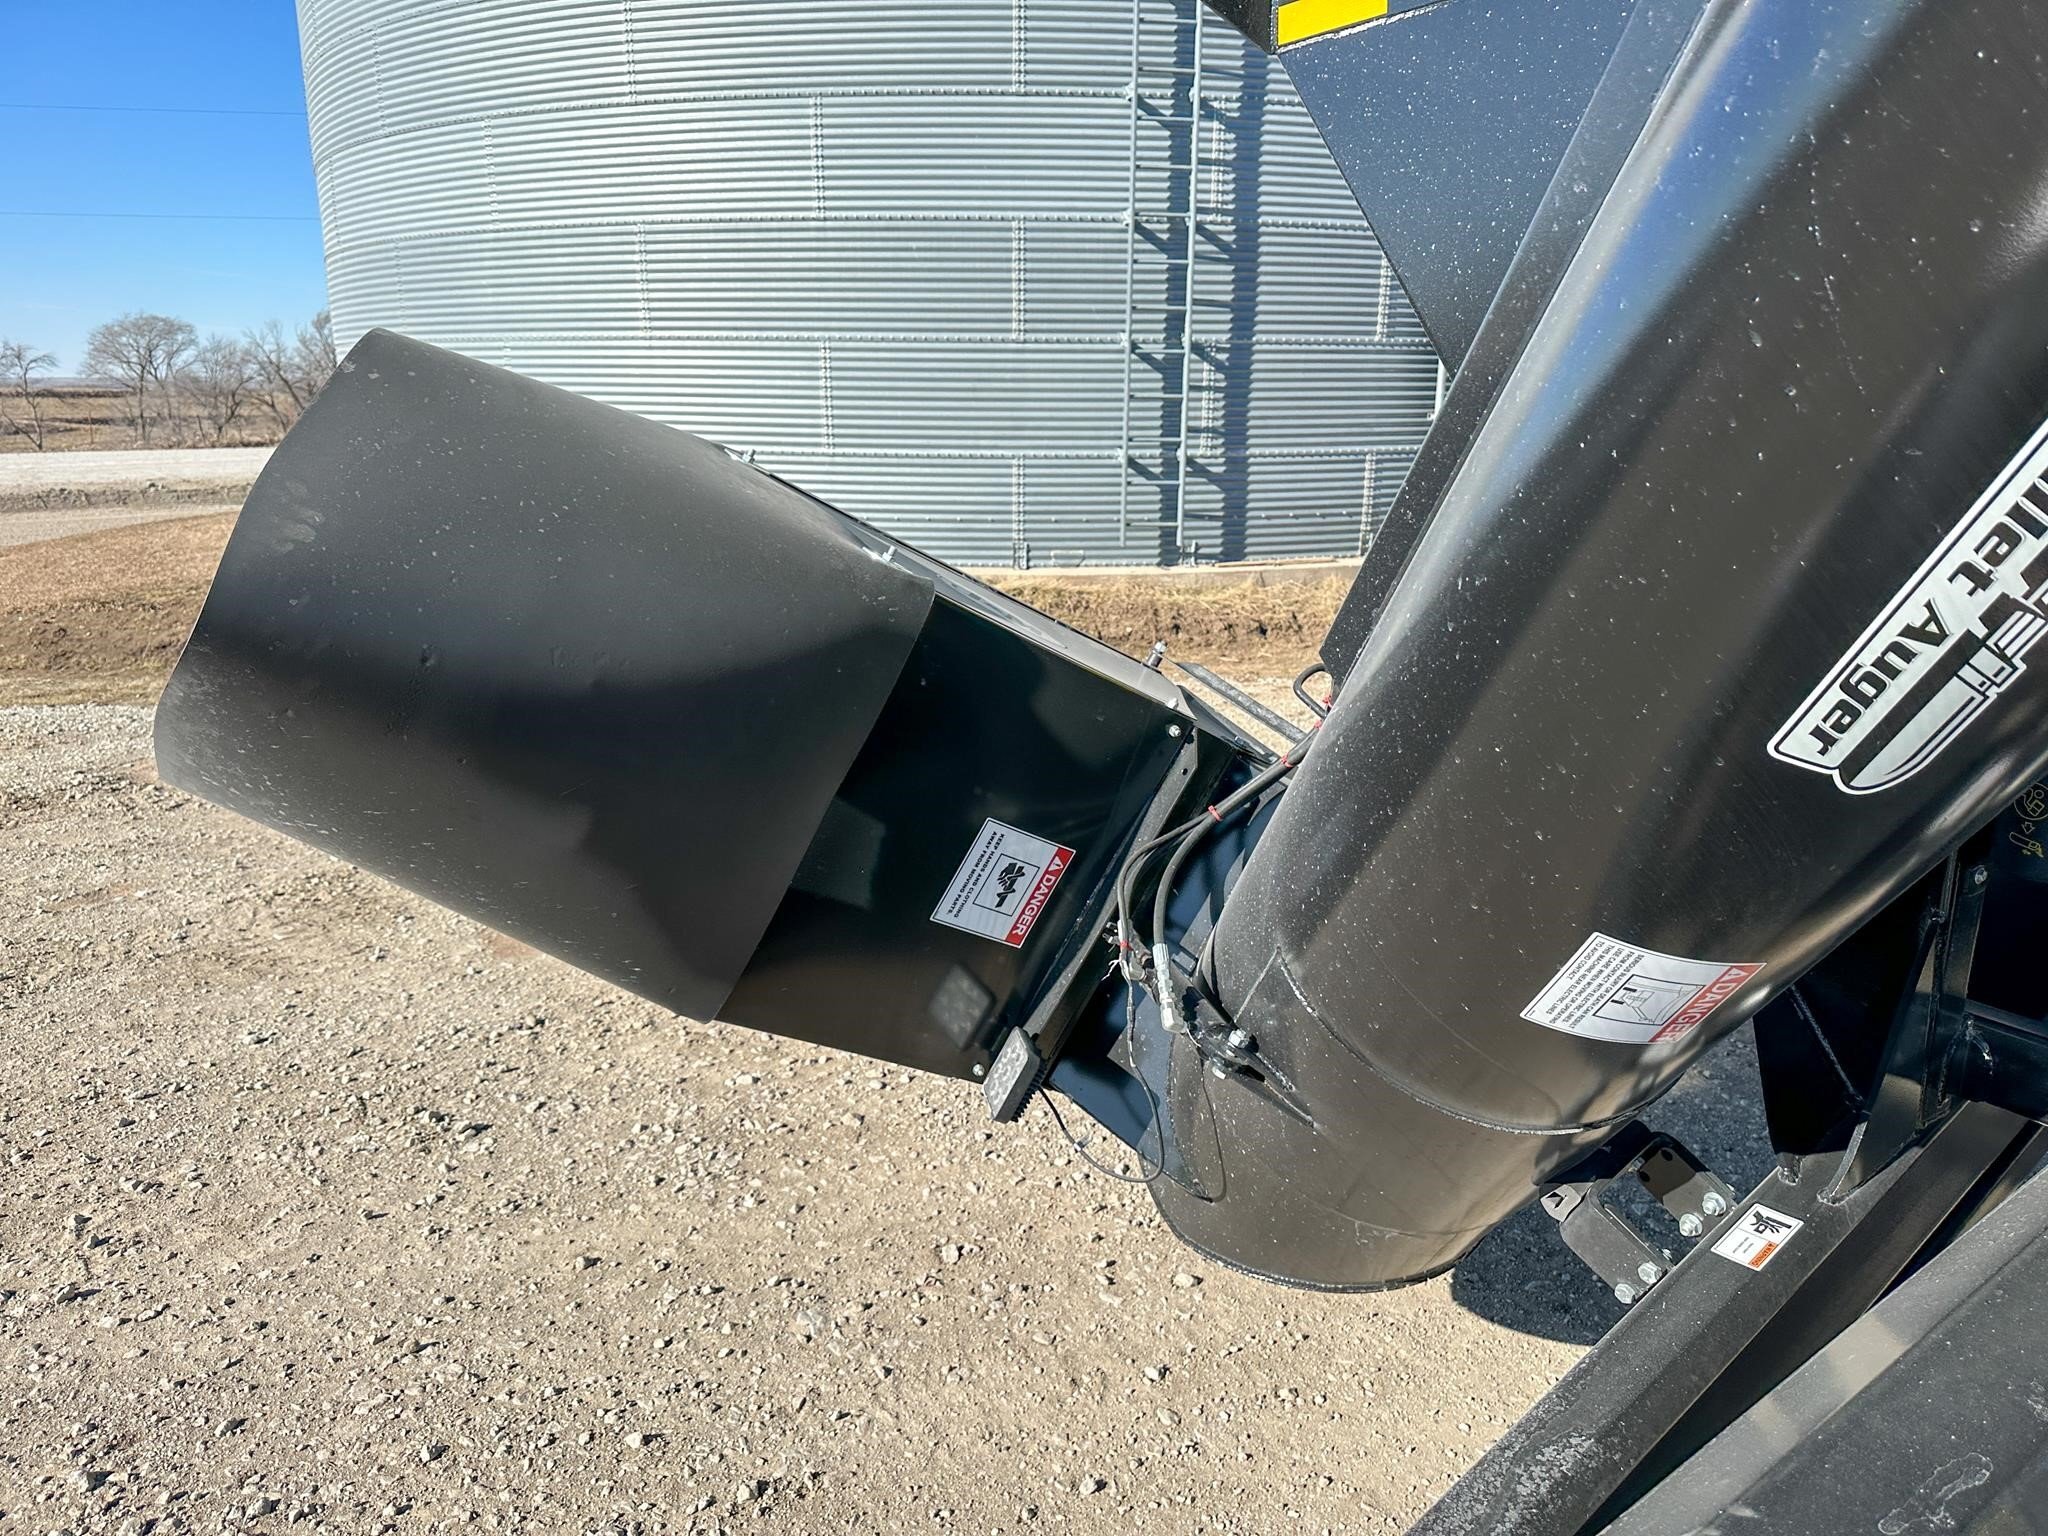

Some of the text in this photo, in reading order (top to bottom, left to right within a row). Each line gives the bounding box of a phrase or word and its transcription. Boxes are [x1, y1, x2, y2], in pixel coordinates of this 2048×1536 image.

[1808, 466, 2048, 757] llet Auger
[974, 850, 988, 868] FROM
[984, 831, 998, 849] AWAY
[953, 833, 1005, 918] KEEP HANDS AND CLOTHING
[959, 868, 977, 893] MOVING
[1012, 874, 1056, 936] DANGER
[1656, 982, 1737, 1041] DANGER
